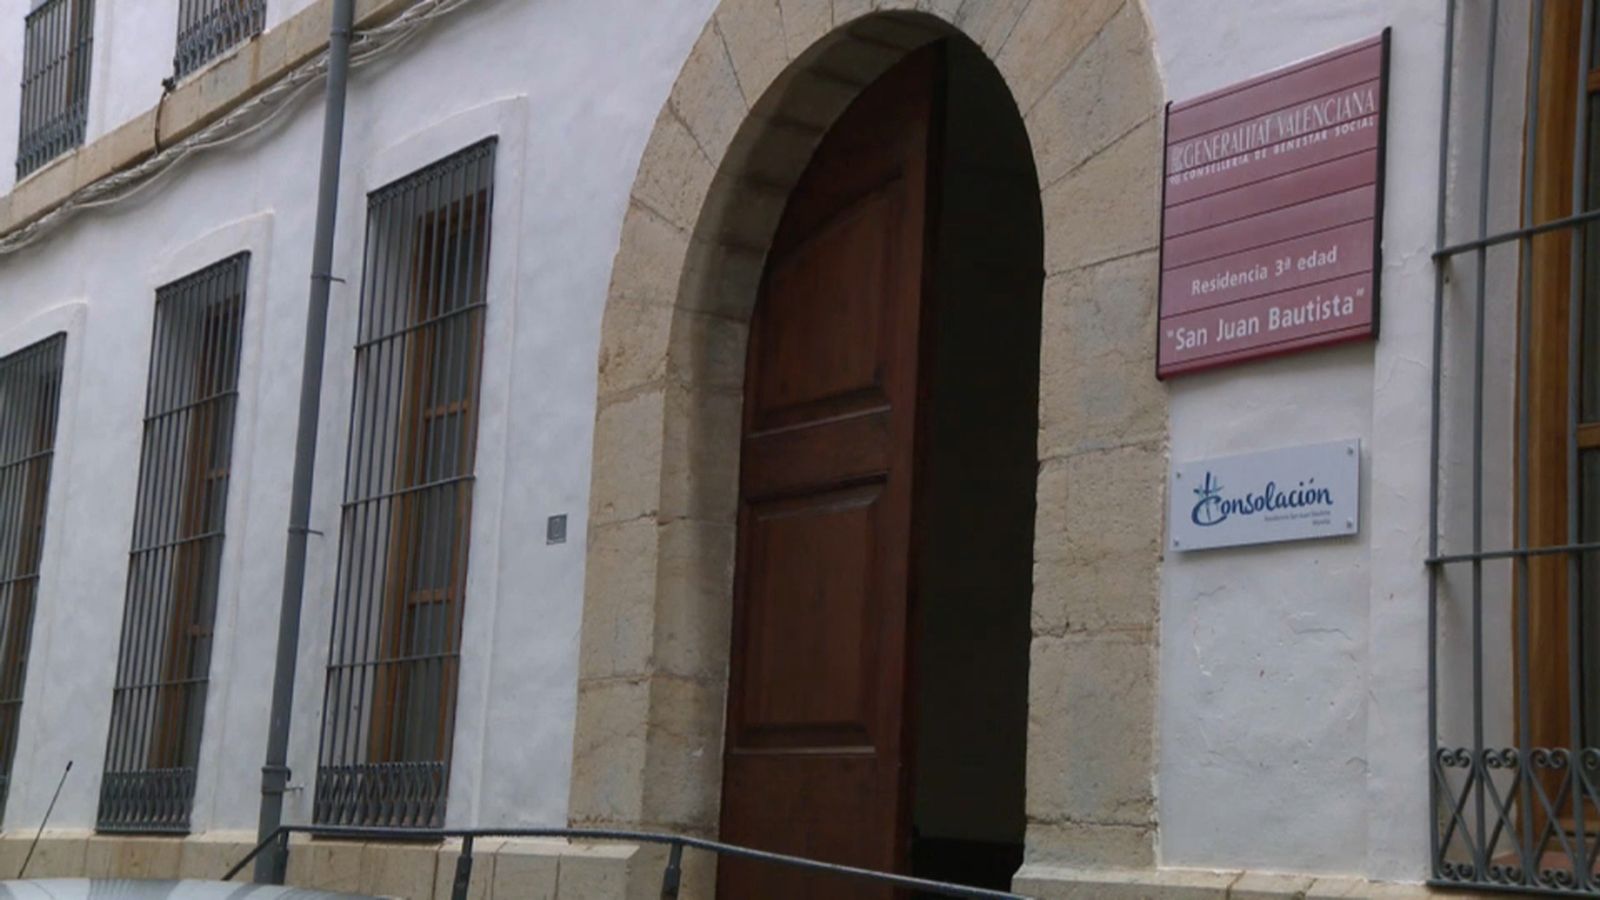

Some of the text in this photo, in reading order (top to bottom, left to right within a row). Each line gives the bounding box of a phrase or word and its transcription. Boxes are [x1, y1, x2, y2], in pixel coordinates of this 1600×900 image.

[1184, 90, 1375, 168] GENERALITAT VALENCIANA
[1254, 147, 1267, 160] DE
[1273, 130, 1328, 154] BENESTAR
[1335, 116, 1374, 137] SOCIAL
[1191, 246, 1337, 296] Residencia 3ª edad
[1216, 316, 1259, 342] Juan
[1191, 476, 1333, 526] Consolación
